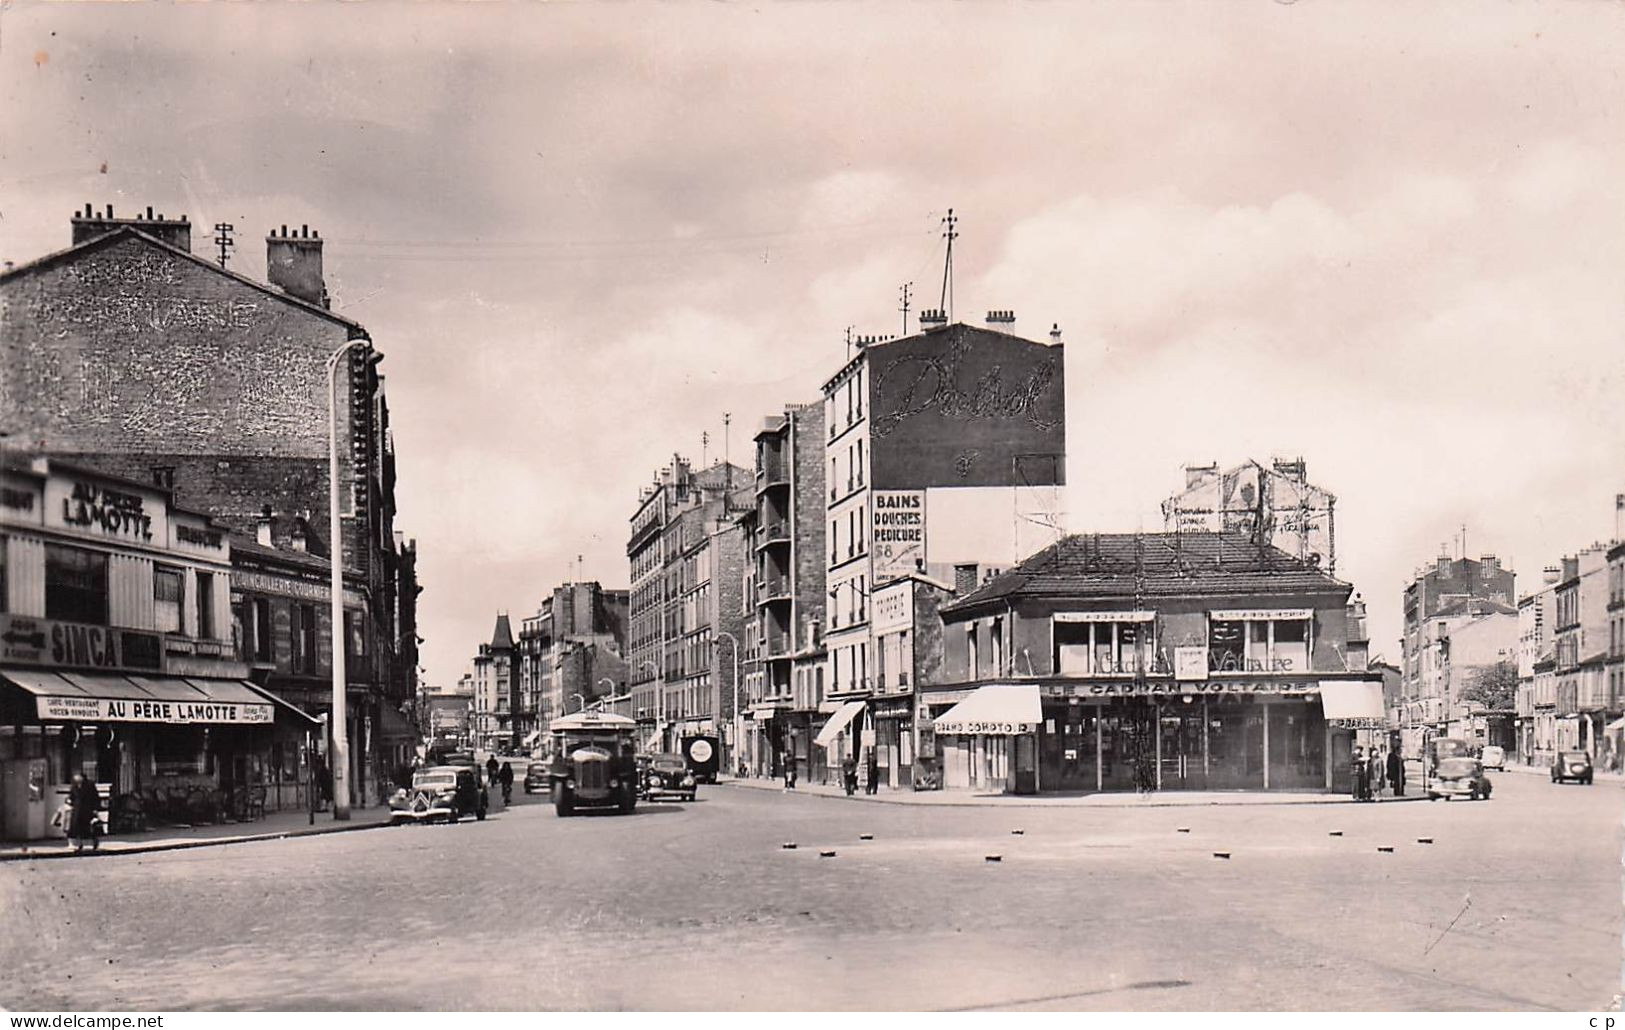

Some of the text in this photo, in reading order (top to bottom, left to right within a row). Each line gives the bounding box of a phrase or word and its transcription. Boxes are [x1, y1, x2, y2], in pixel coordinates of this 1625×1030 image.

[877, 496, 921, 508] BAINS
[63, 498, 153, 540] LAMOTTE
[874, 513, 921, 525] DOUCHES
[874, 529, 922, 542] PEDICURE
[52, 623, 117, 667] SIMCA
[1195, 682, 1308, 693] VOLTAIRE
[108, 701, 126, 718] AU
[177, 704, 236, 720] LAMOTTE
